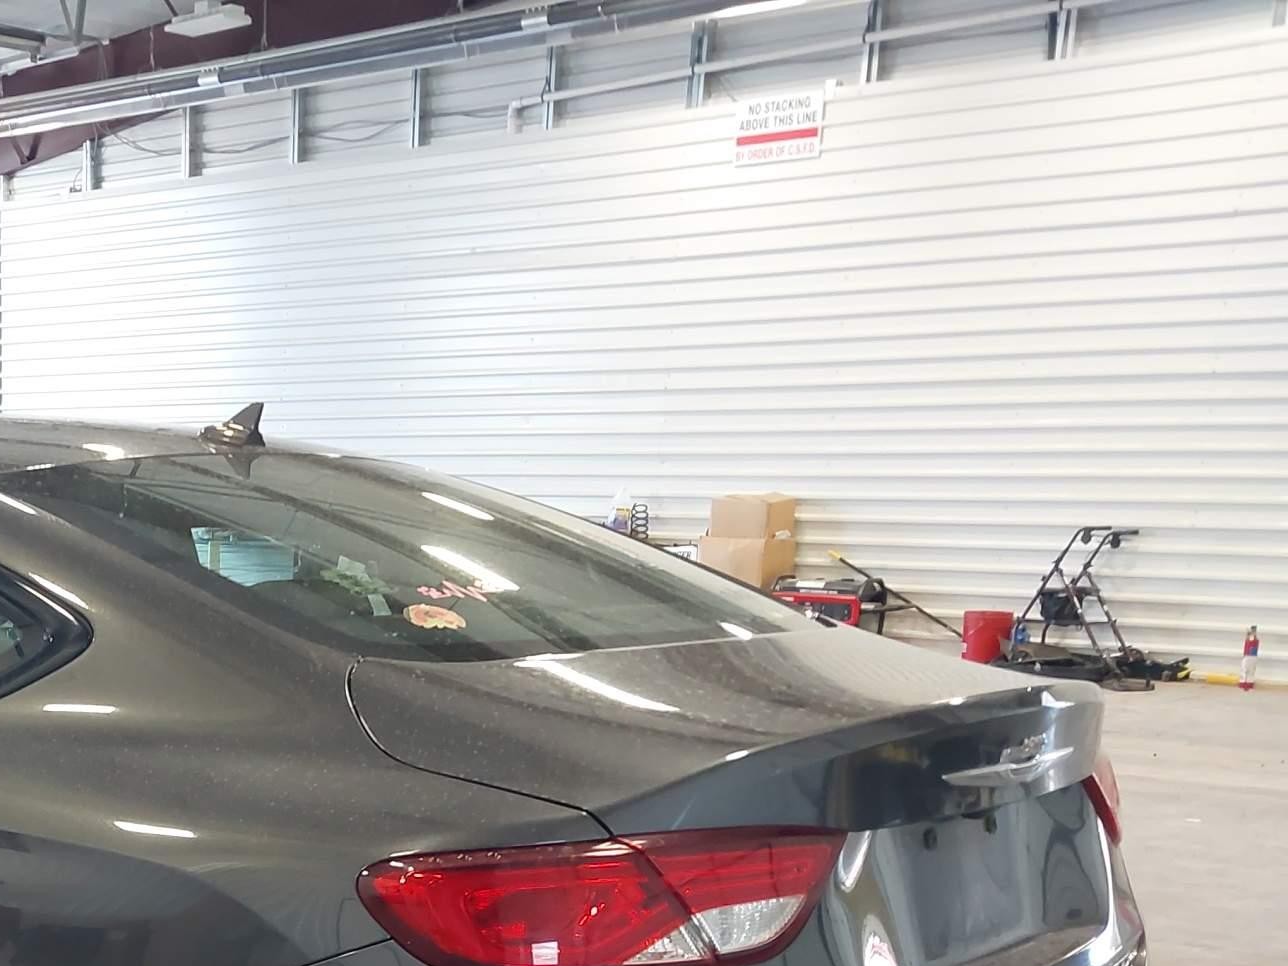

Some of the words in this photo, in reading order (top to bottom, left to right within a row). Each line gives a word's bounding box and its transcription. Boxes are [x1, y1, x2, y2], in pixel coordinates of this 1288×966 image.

[748, 103, 762, 115] NO
[764, 96, 811, 113] STACKING
[739, 117, 769, 130] ABOVE
[774, 113, 793, 127] THIS
[797, 110, 817, 125] LINE
[736, 151, 745, 162] BY
[747, 147, 773, 161] ORDER
[776, 145, 786, 157] OF
